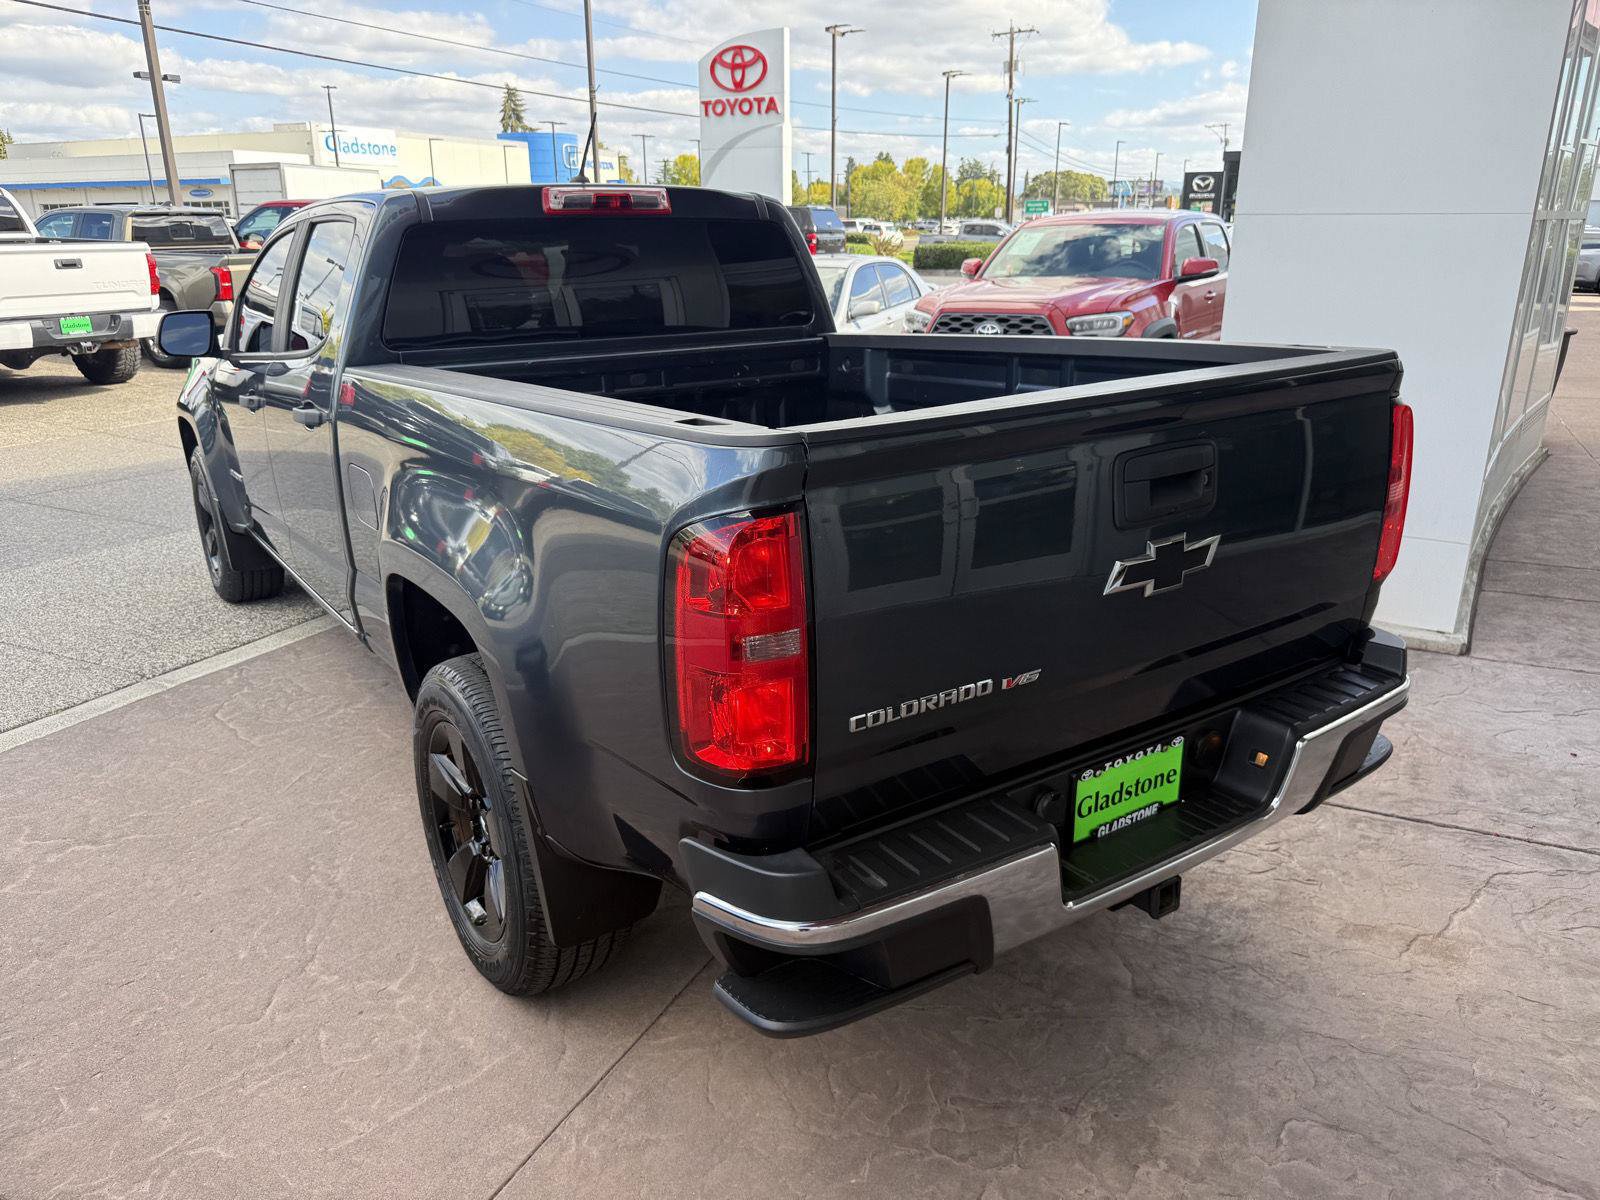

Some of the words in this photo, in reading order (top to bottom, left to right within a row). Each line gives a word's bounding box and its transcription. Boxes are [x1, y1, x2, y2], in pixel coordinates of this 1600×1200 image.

[701, 97, 779, 117] TOYOTA
[325, 135, 397, 156] Gladstone
[849, 678, 994, 733] COLORADO
[1001, 668, 1042, 690] V6
[1104, 744, 1162, 772] TOYOTA
[1076, 768, 1178, 819] Gladstone
[1097, 802, 1159, 838] GLADSTONE
